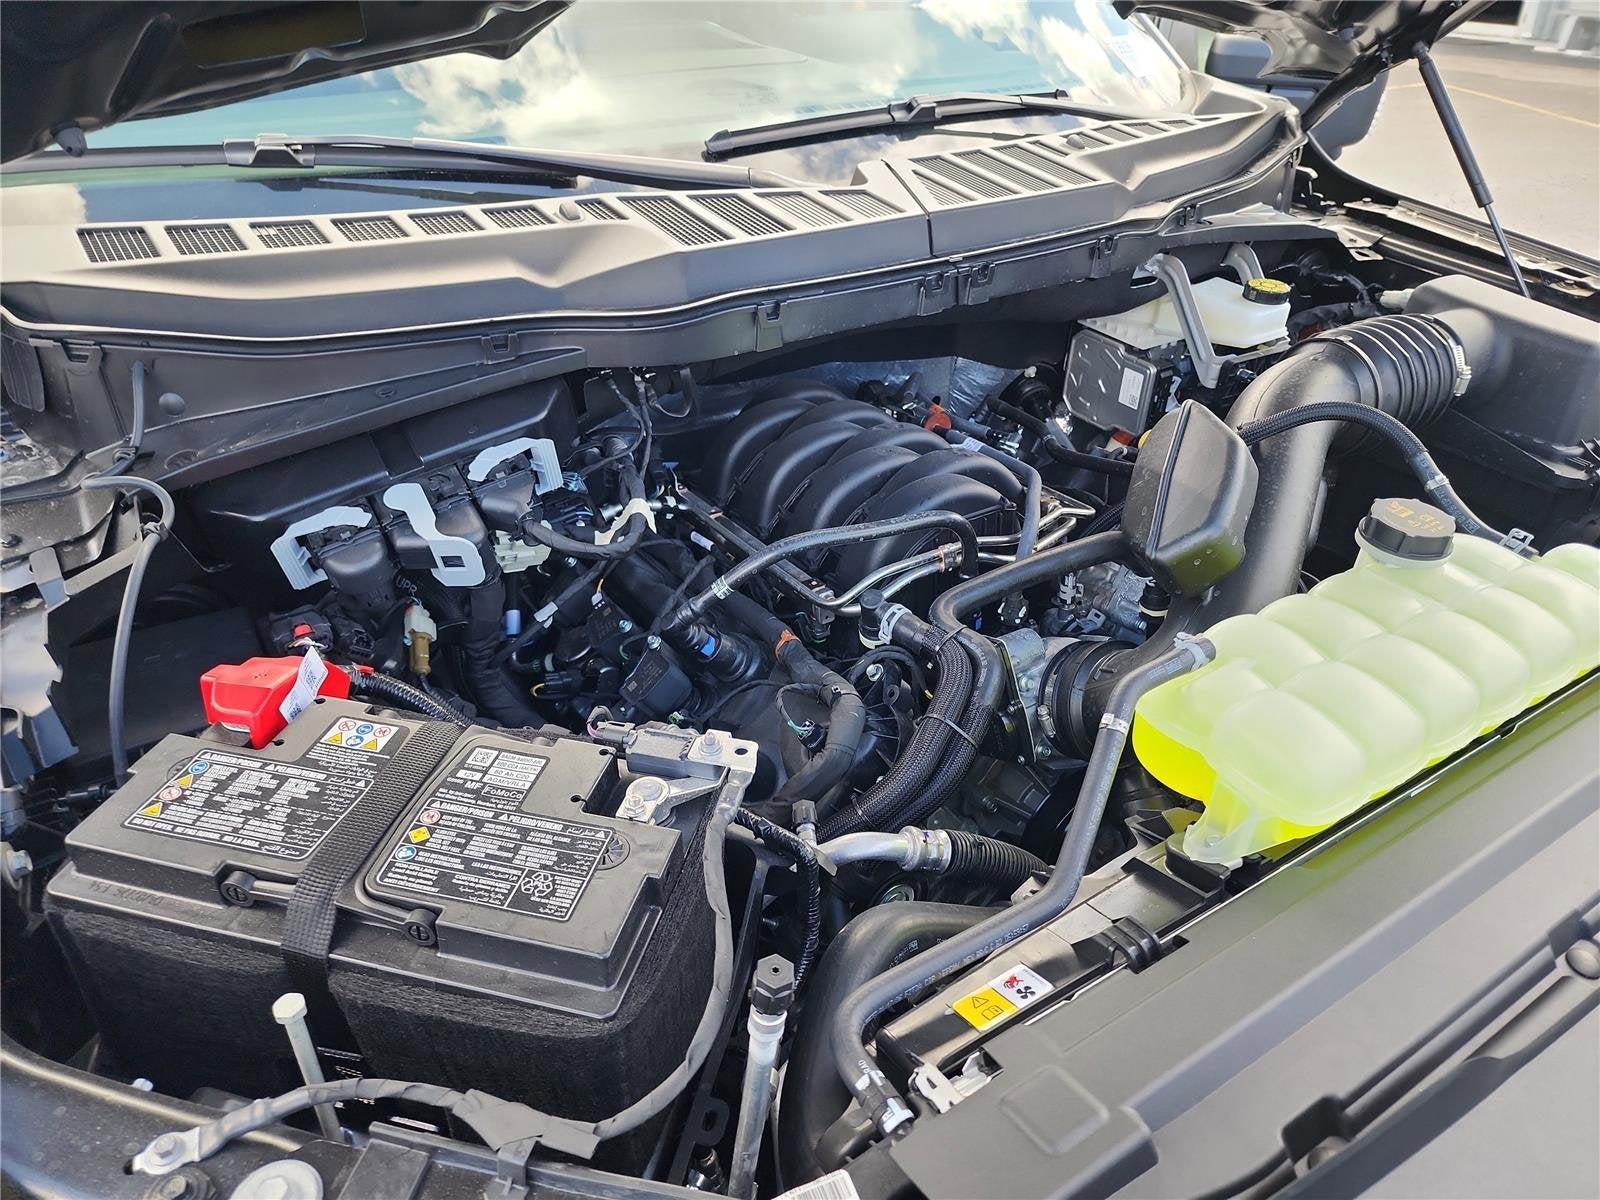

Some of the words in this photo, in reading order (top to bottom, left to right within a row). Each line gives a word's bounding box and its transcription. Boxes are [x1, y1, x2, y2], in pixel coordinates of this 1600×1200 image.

[396, 575, 417, 596] UPR
[484, 786, 523, 799] FoMoCo
[440, 802, 495, 817] DANGER/POISON
